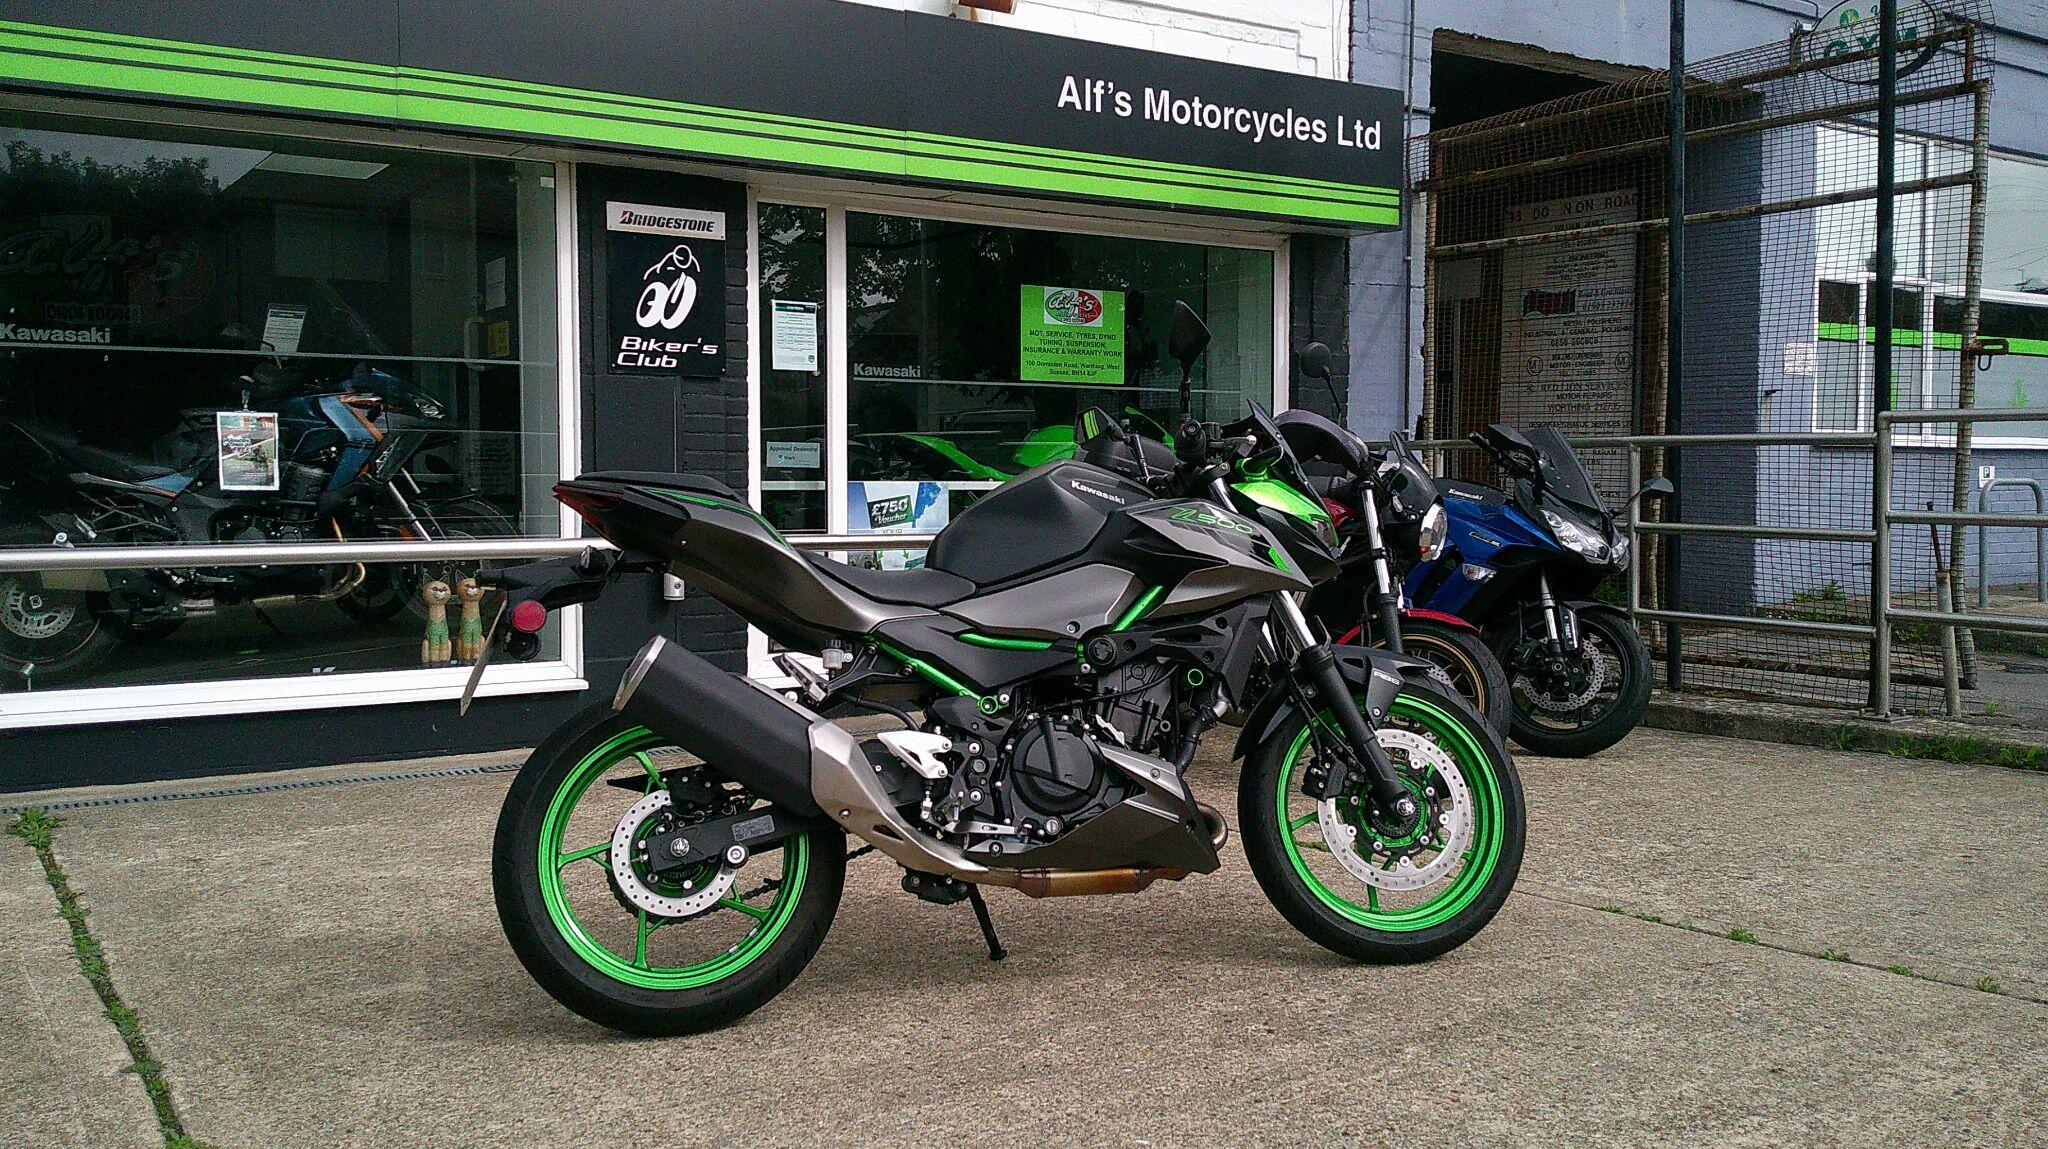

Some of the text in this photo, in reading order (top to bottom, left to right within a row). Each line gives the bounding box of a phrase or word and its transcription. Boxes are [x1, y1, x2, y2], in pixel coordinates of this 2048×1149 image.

[1057, 75, 1382, 150] Alf's Motorcycles Ltd
[619, 210, 715, 233] BRIDGESTONE
[0, 322, 111, 344] Kawasaki
[621, 336, 719, 355] Biker's
[1023, 346, 1060, 355] INSURANCE
[1067, 349, 1101, 357] WARRANTY
[1103, 350, 1123, 358] WORK
[617, 352, 678, 368] Club
[853, 362, 921, 378] Kawasaki
[1070, 480, 1126, 505] Kawasaki
[873, 499, 909, 518] £750
[874, 513, 908, 525] Voucher
